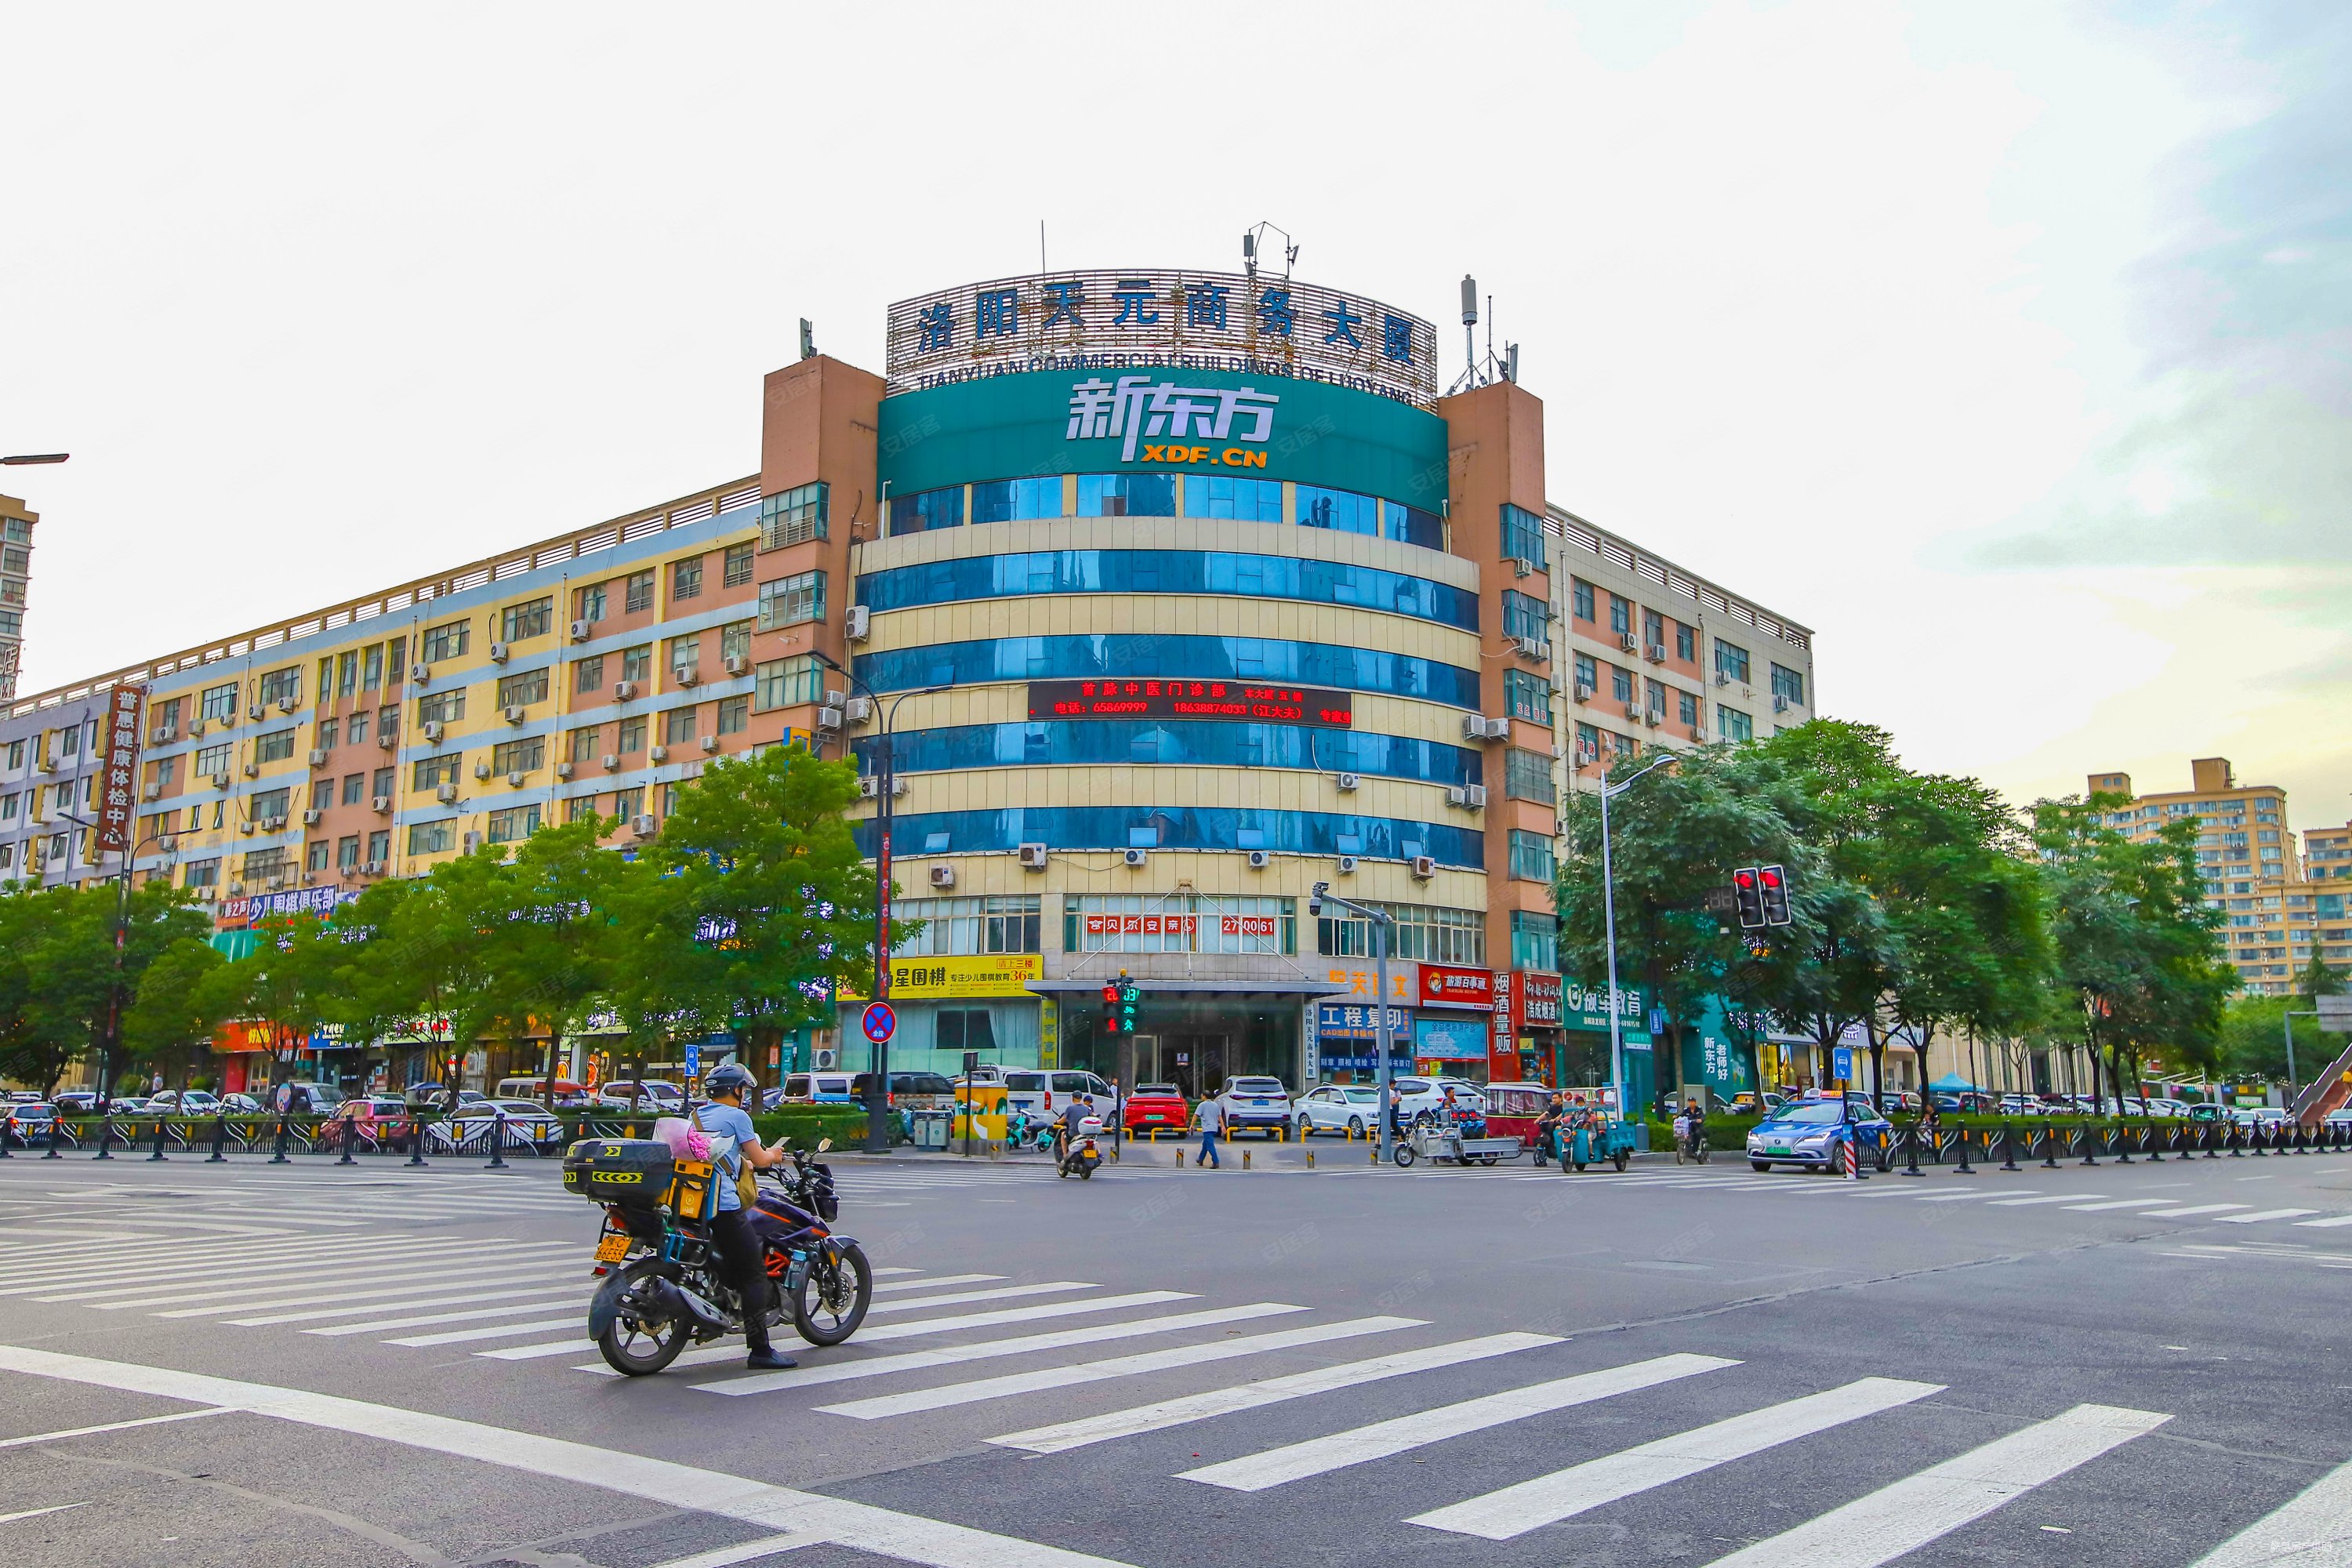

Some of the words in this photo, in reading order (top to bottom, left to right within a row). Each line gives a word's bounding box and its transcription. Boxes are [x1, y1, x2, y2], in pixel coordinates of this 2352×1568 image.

[916, 280, 1415, 365] 洛阳天元商务大厦
[917, 361, 1024, 391] TIANYUAN
[1029, 353, 1173, 372] COMMERCIAL
[1182, 355, 1294, 378] BUILDINGS
[1301, 366, 1323, 383] OF
[1328, 373, 1412, 405] LUOYANG
[1066, 376, 1279, 462] 新东方
[1141, 445, 1268, 468] XDF.CN
[1082, 682, 1225, 698] 首脉中医门诊部
[1516, 702, 1547, 720] 定点医保
[1578, 739, 1595, 756] 首脉
[103, 691, 137, 844] 普惠健康体检中心
[250, 887, 335, 921] 少儿围棋俱乐部
[998, 959, 1033, 968] 请上三楼
[890, 967, 946, 988] 星围棋
[950, 970, 1035, 982] 专注少儿围棋教育36年
[1444, 975, 1487, 990] 旅游百事通
[1322, 1007, 1401, 1031] 工程复印
[1494, 975, 1512, 1054] 烟酒量贩
[1305, 1009, 1314, 1076] 洛阳天元商务大厦
[1321, 1029, 1350, 1037] CAD出图
[1704, 1036, 1715, 1074] 新东方
[1716, 1044, 1729, 1081] 老师好
[597, 1247, 625, 1261] 66E55
